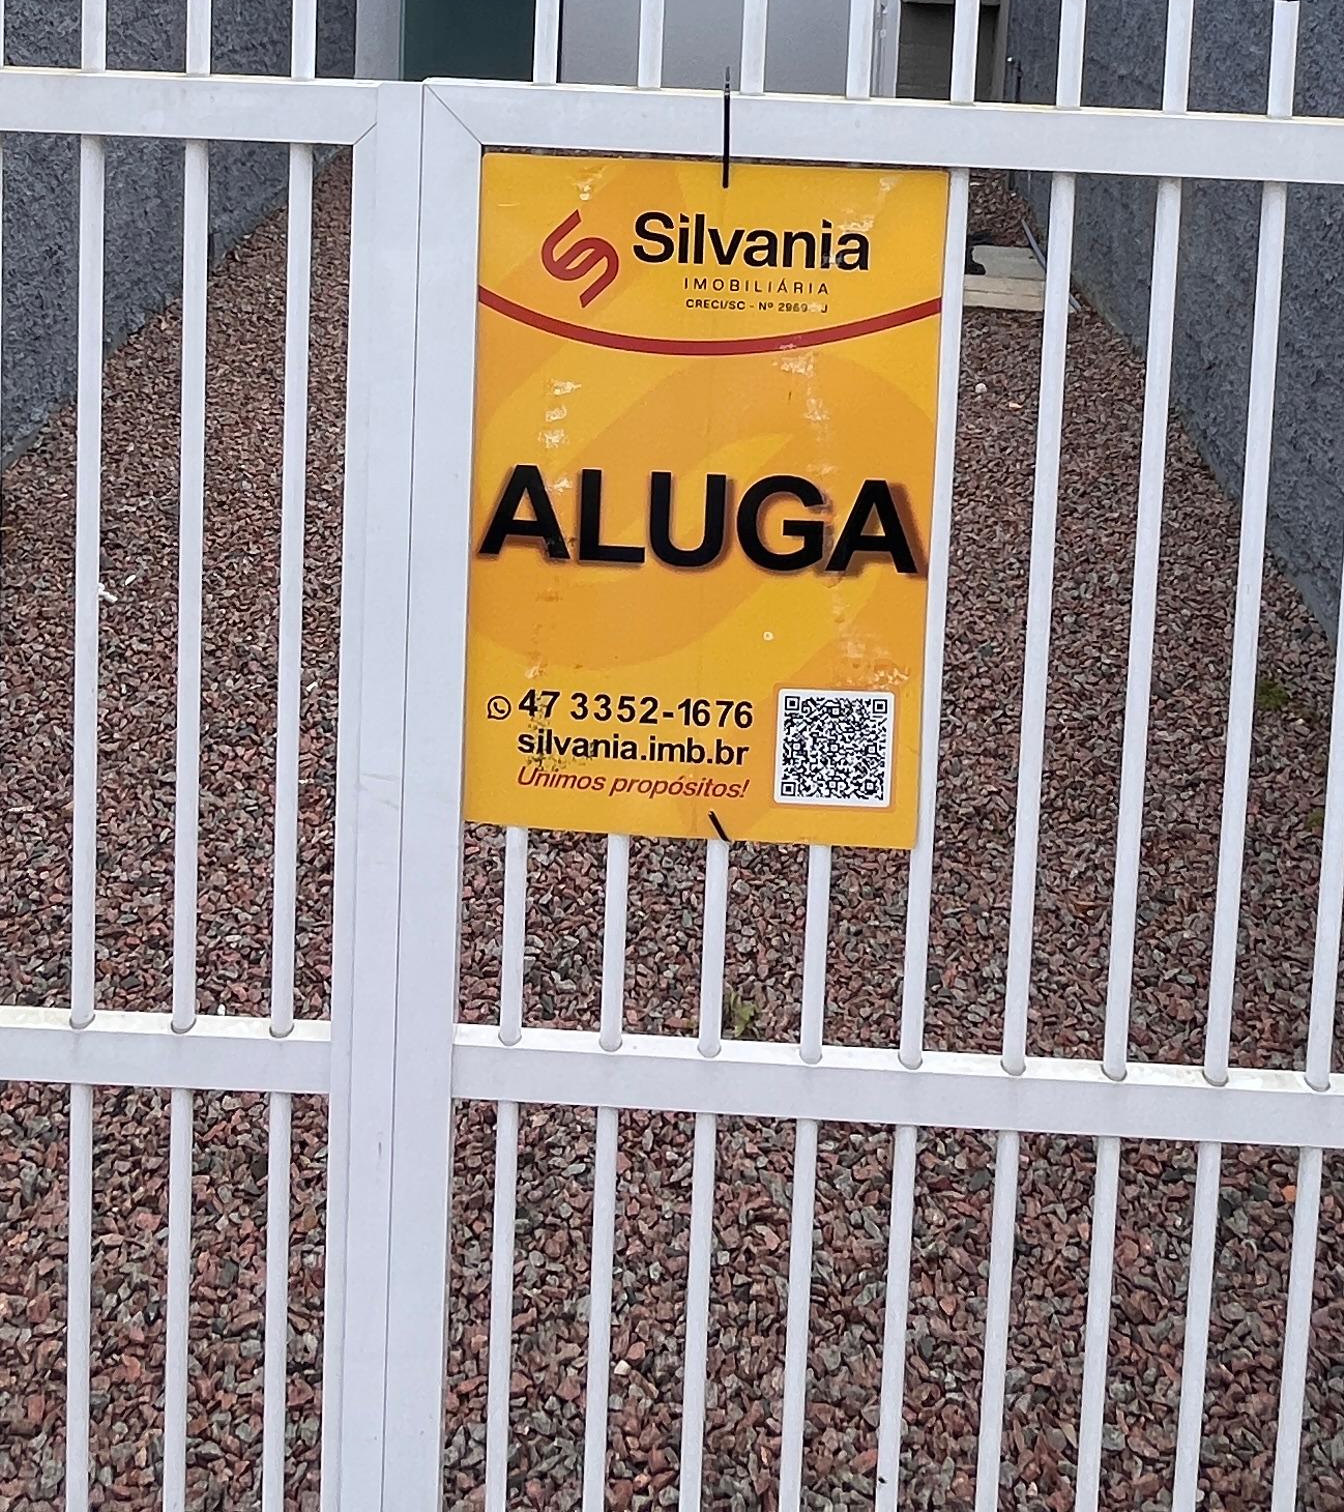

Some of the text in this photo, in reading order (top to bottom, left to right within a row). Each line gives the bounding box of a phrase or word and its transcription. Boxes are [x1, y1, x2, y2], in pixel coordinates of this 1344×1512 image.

[632, 211, 870, 271] Silvania
[684, 277, 829, 295] IMOBILIÁRIA
[685, 299, 746, 311] CRECI/SC
[478, 464, 919, 574] ALUGA
[518, 689, 754, 729] 47 3352-1676
[517, 728, 750, 766] silvania.imb.br
[609, 775, 751, 800] propósitos!
